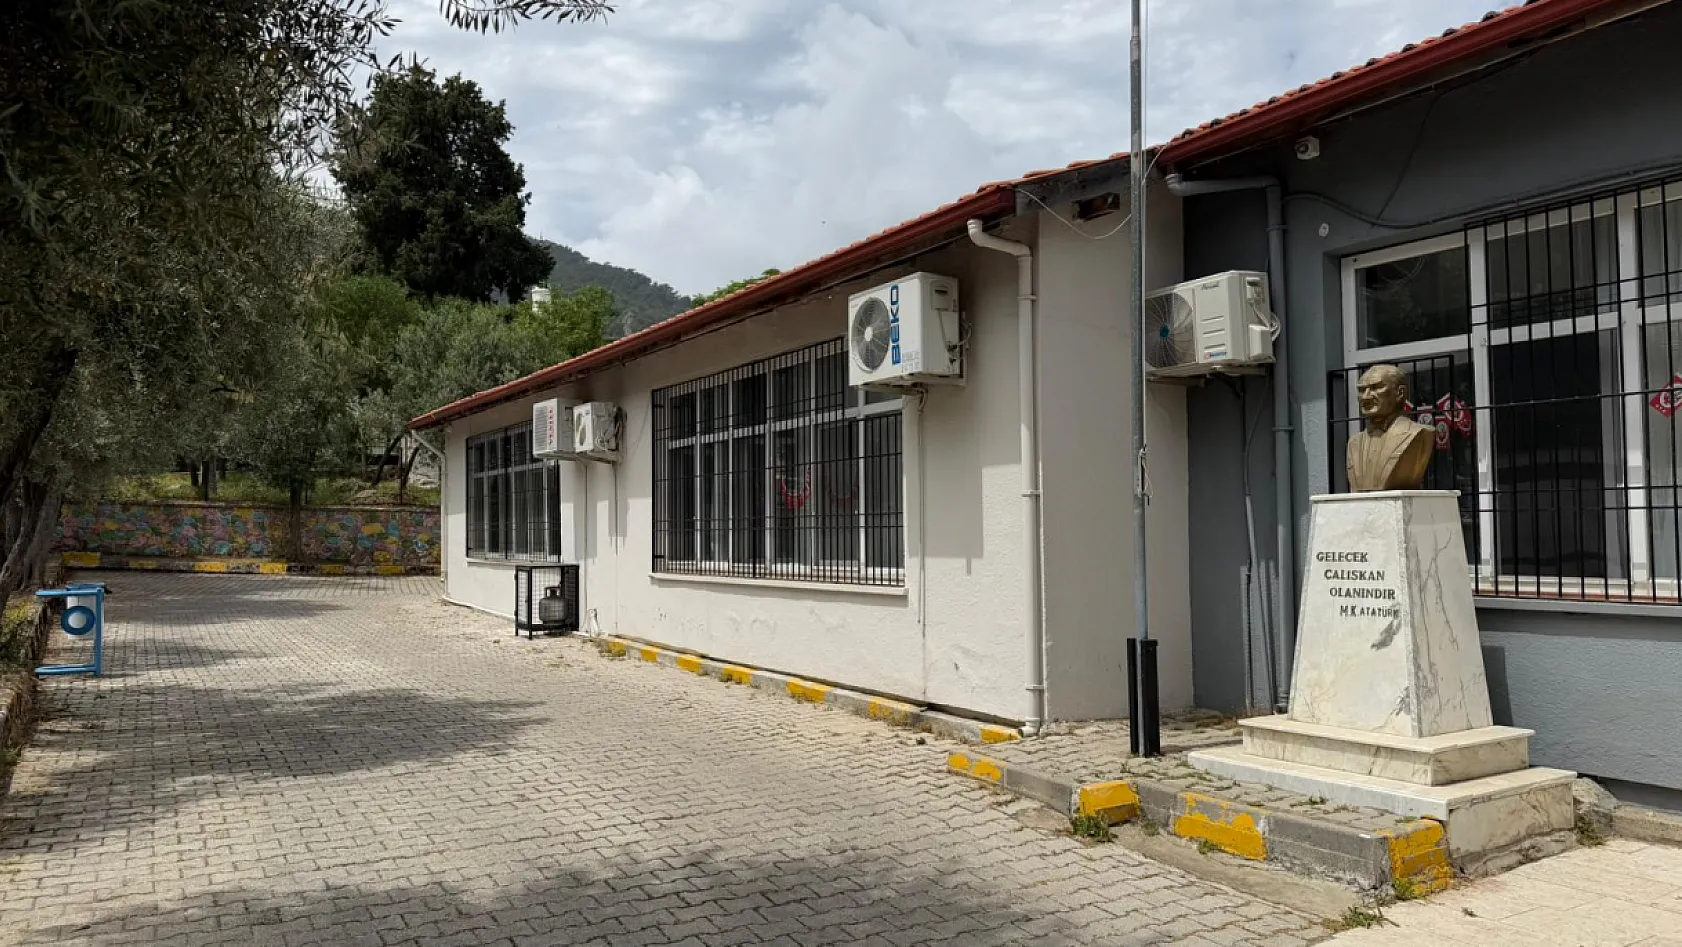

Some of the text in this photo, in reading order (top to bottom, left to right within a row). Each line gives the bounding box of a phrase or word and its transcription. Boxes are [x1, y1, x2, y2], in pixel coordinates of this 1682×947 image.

[890, 285, 901, 364] BEKO
[1316, 551, 1368, 563] GELECEK
[1329, 587, 1396, 600] OLANINDIR
